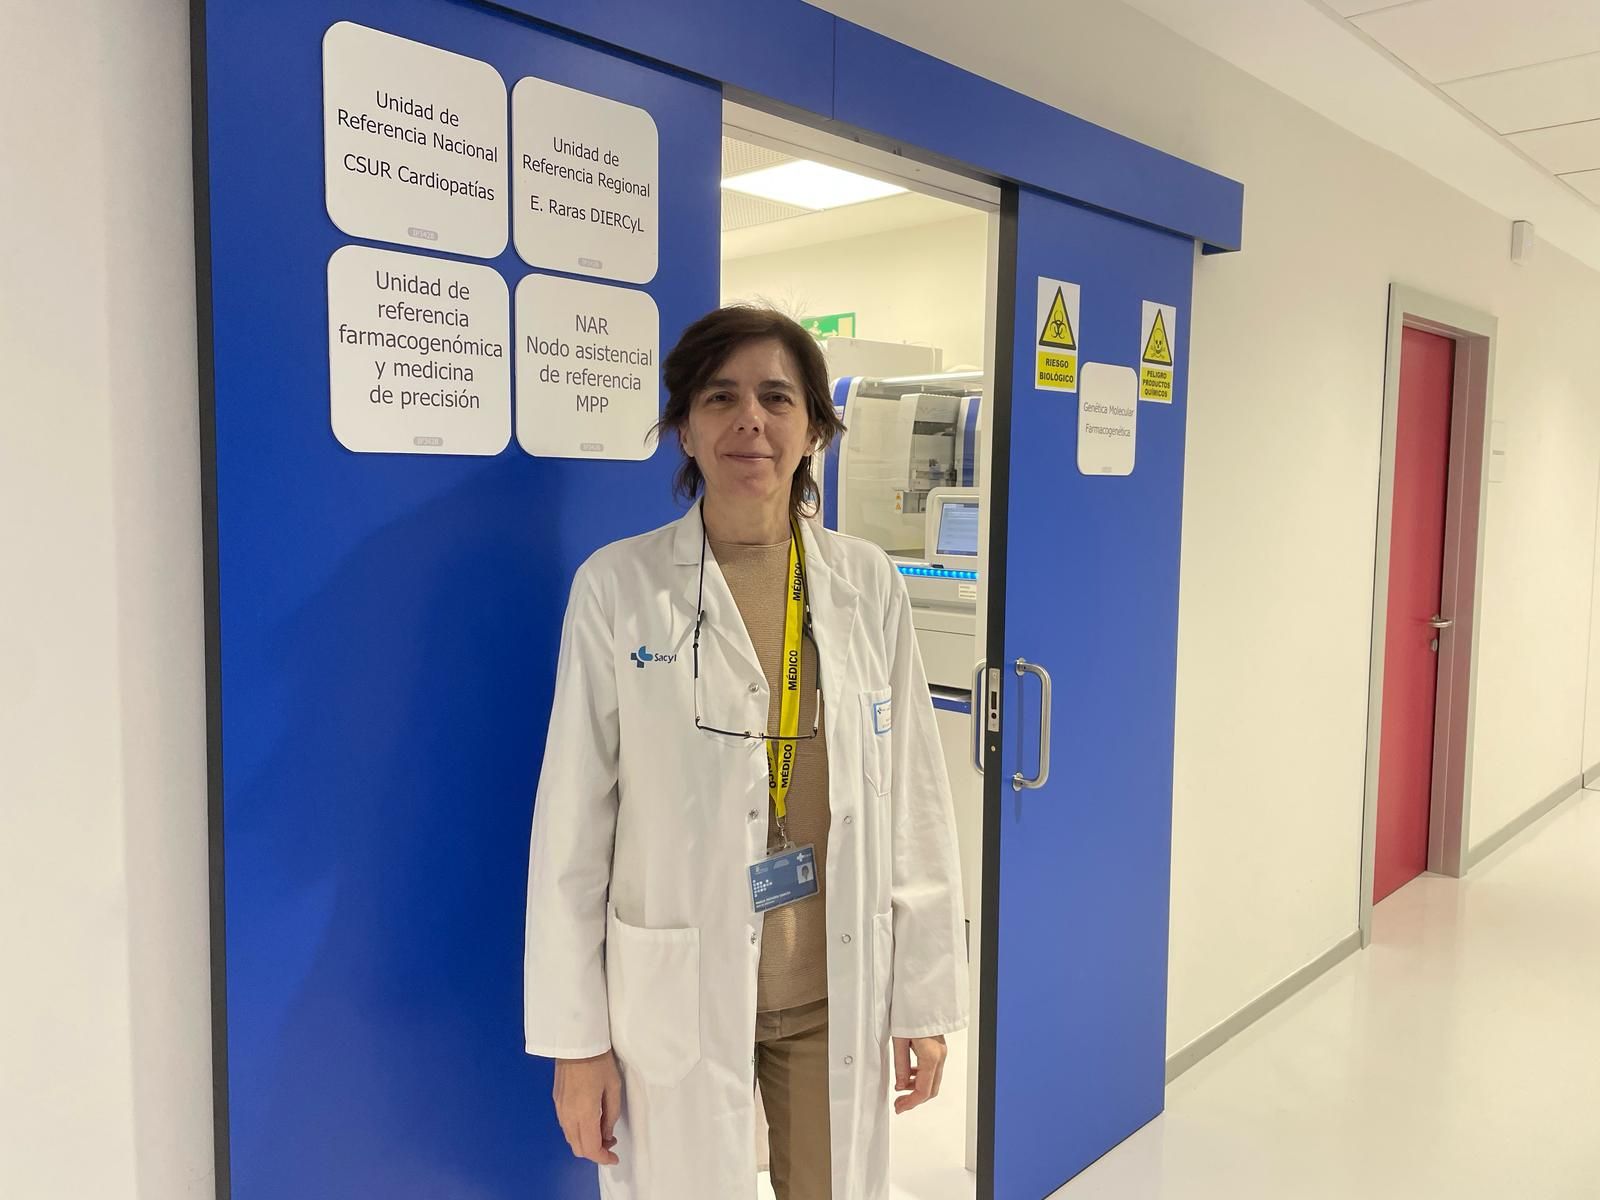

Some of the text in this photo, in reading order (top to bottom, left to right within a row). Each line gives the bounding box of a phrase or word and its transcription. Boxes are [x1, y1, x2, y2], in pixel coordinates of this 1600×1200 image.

[376, 90, 460, 127] Unidad de
[337, 108, 498, 163] Referencia Nacional
[553, 136, 620, 167] Unidad de
[343, 153, 495, 201] CSUR Cardiopatías
[522, 153, 650, 198] Referencia Regional
[530, 195, 645, 234] E. Raras DIERCyL
[376, 270, 470, 301] Unidad de
[377, 301, 469, 327] referencia
[575, 314, 609, 336] NAR
[338, 323, 503, 358] farmacogenómica
[526, 335, 653, 367] Nodo asistencial
[374, 360, 474, 382] y medicina
[1045, 357, 1069, 369] RIESGO
[1147, 370, 1167, 380] PELIGRO
[539, 364, 641, 391] de referencia
[1039, 371, 1074, 384] BIOLÓGICO
[1142, 379, 1171, 389] PRODUCTOS
[369, 384, 480, 410] de precisión
[576, 394, 609, 413] MPP
[1083, 401, 1135, 417] Genética Molecular
[1085, 423, 1131, 438] Farmacogenética
[791, 562, 802, 601] MÉDICO
[654, 652, 677, 664] Sacyl
[786, 649, 799, 691] MÉDICO
[780, 744, 793, 788] MÉDICO
